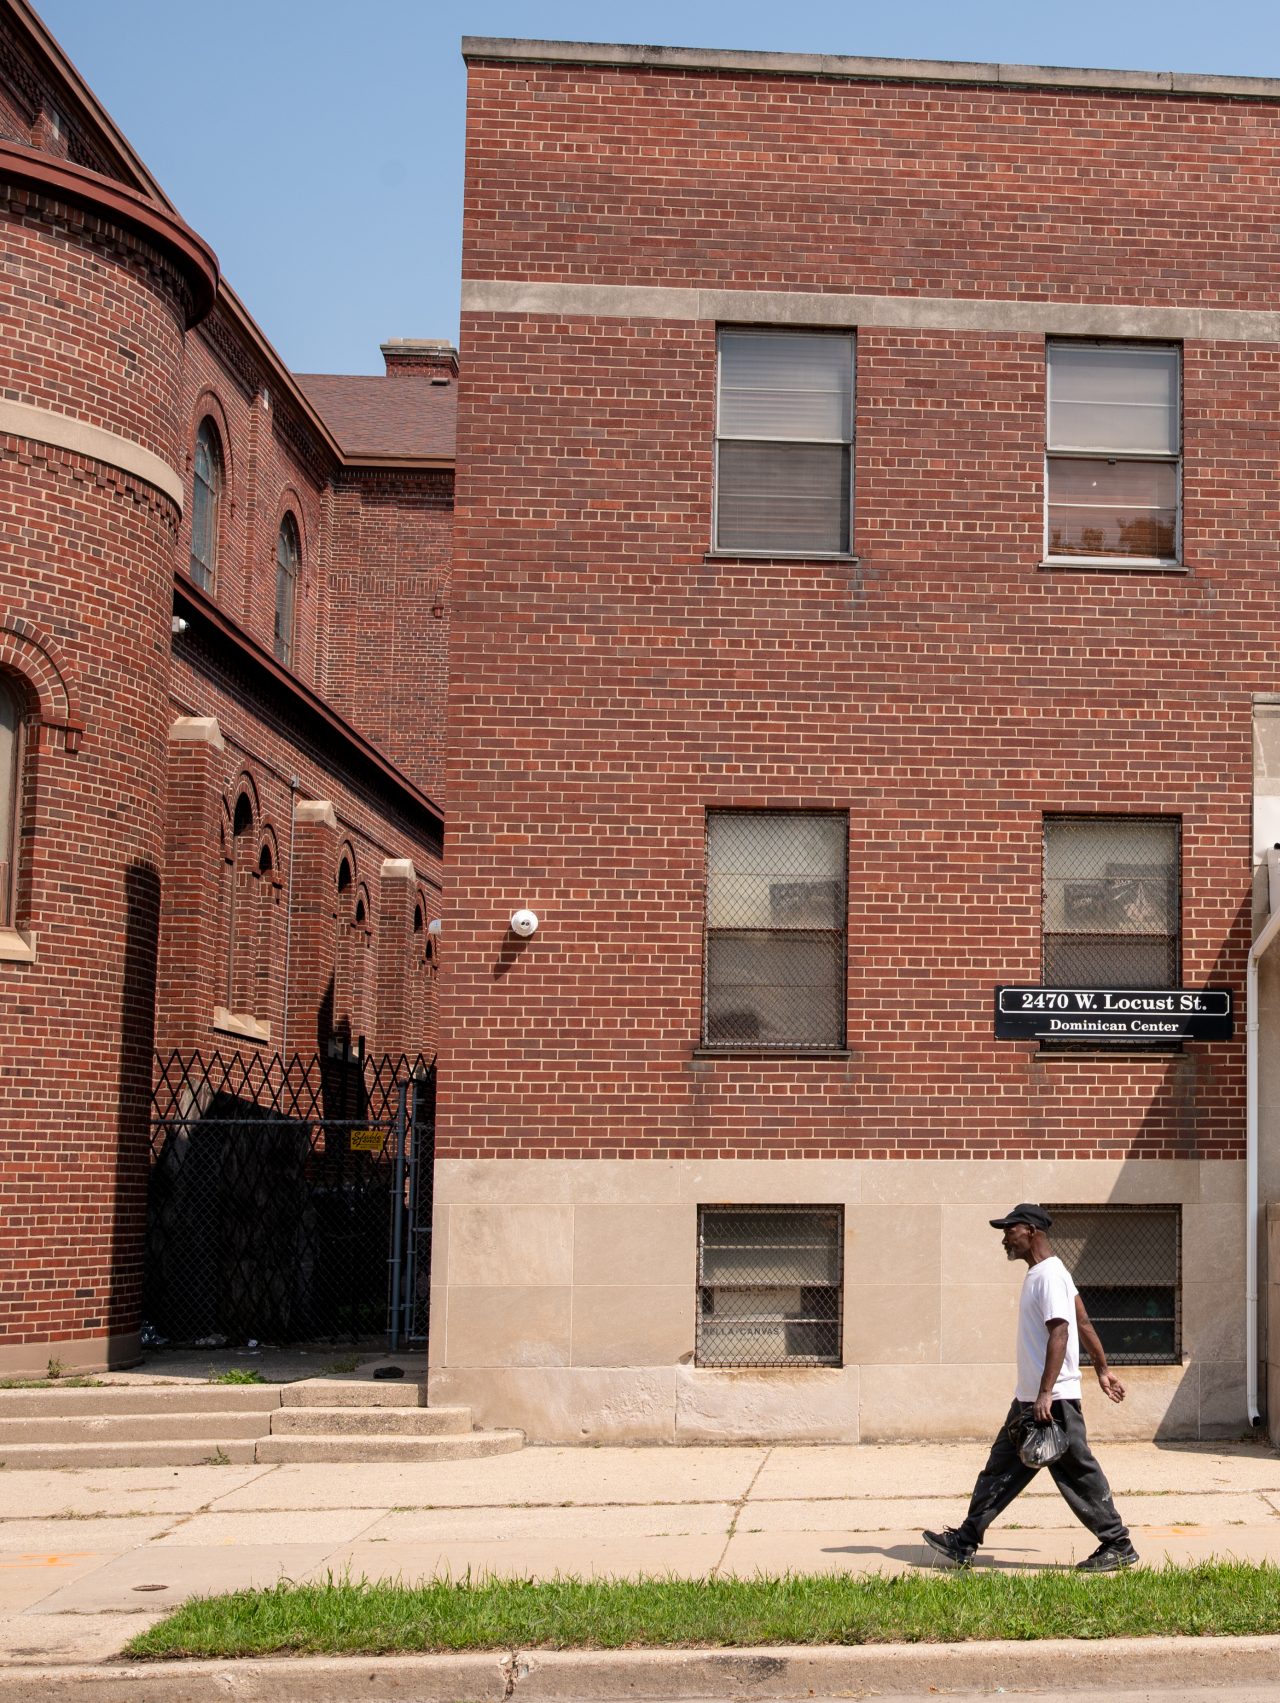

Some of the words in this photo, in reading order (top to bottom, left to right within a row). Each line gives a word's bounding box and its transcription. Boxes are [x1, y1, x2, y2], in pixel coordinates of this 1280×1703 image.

[1021, 993, 1069, 1009] 2470
[1075, 994, 1098, 1009] W.
[1103, 994, 1174, 1010] Locust
[1180, 995, 1207, 1011] St.
[1050, 1019, 1127, 1031] Dominican
[1130, 1020, 1179, 1032] Center
